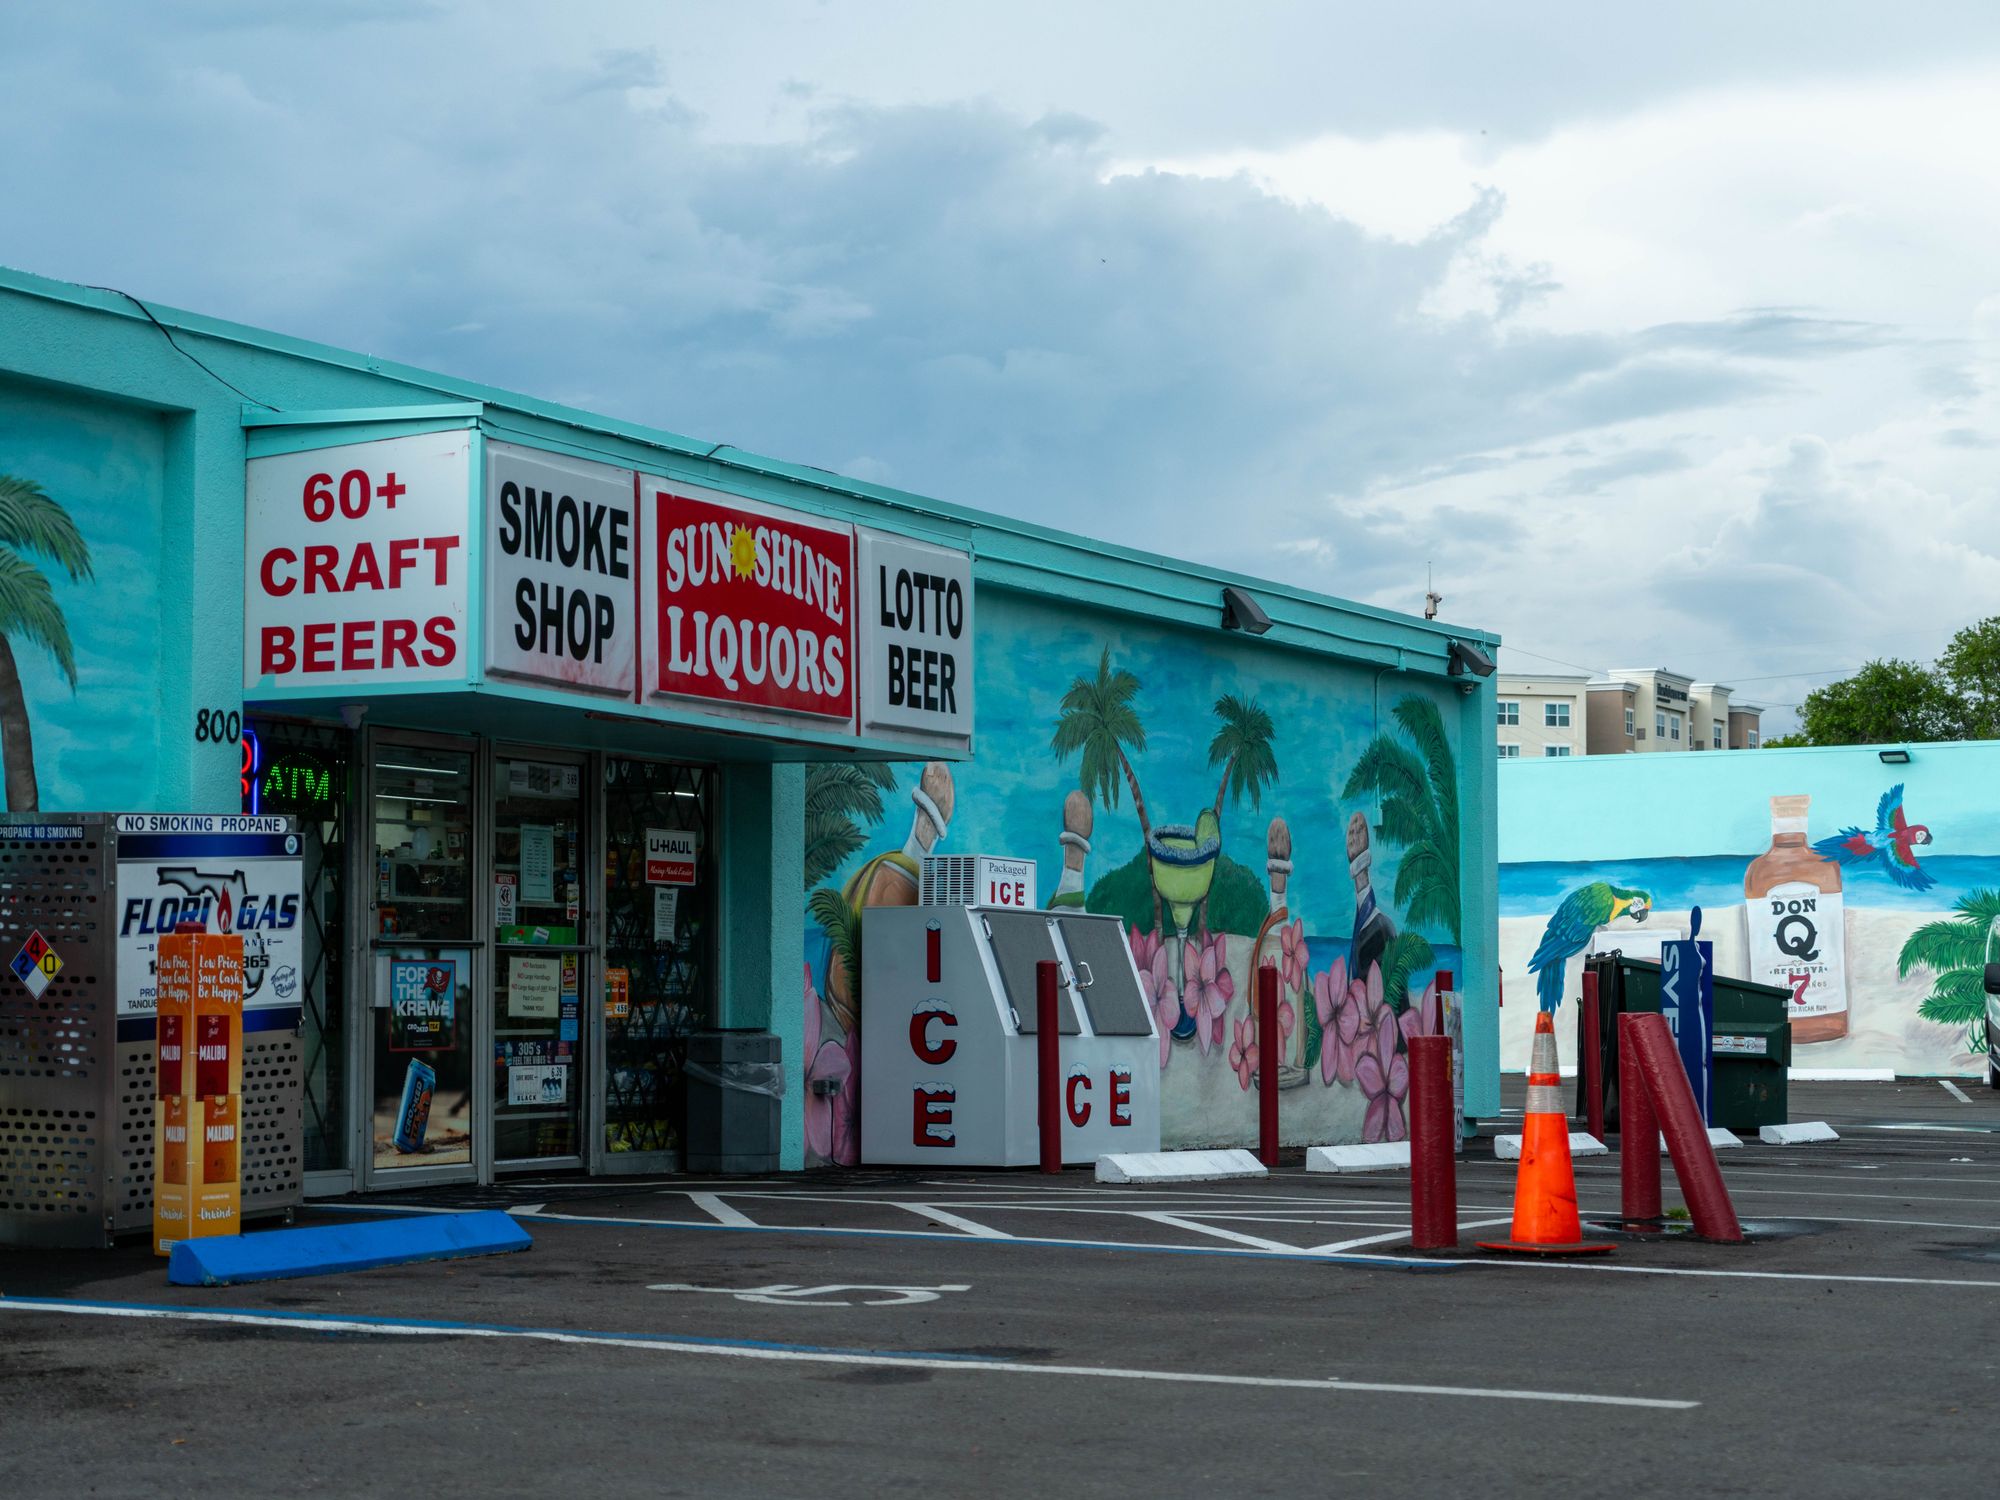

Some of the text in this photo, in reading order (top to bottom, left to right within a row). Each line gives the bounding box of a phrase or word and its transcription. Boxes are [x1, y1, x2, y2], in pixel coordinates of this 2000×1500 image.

[302, 469, 407, 523] 60+
[499, 480, 630, 581] SMOKE
[259, 535, 460, 598] CRAFT
[879, 563, 964, 641] LOTTO
[514, 576, 616, 665] SHOP
[260, 615, 457, 676] BEERS
[667, 605, 845, 699] LIQUORS
[888, 643, 958, 716] BEER
[195, 708, 240, 744] 800
[262, 765, 329, 801] ATM
[0, 825, 83, 839] PROPANE NO SMOKING
[125, 816, 281, 832] NO SMOKING PROPANE
[650, 838, 692, 855] U-HAUL
[989, 862, 1027, 876] Packaged
[991, 880, 1025, 906] ICE
[237, 894, 299, 931] GAS
[1771, 899, 1817, 915] DON
[30, 938, 40, 957] 4
[1773, 914, 1820, 962] Q
[19, 953, 55, 975] 2 0
[199, 955, 241, 970] Low Price.
[1773, 966, 1824, 975] RESERVA
[198, 969, 242, 985] Save Cash.
[396, 966, 428, 983] FOR
[198, 985, 241, 1004] Be Happy.
[396, 984, 427, 1000] THE
[1789, 972, 1811, 1005] 7
[396, 1000, 450, 1016] KREWE
[161, 1045, 181, 1061] MALIBU
[199, 1045, 228, 1061] MALIBU
[518, 1041, 541, 1056] 305's
[1065, 1062, 1133, 1127] CE
[206, 1124, 235, 1142] MALIBU
